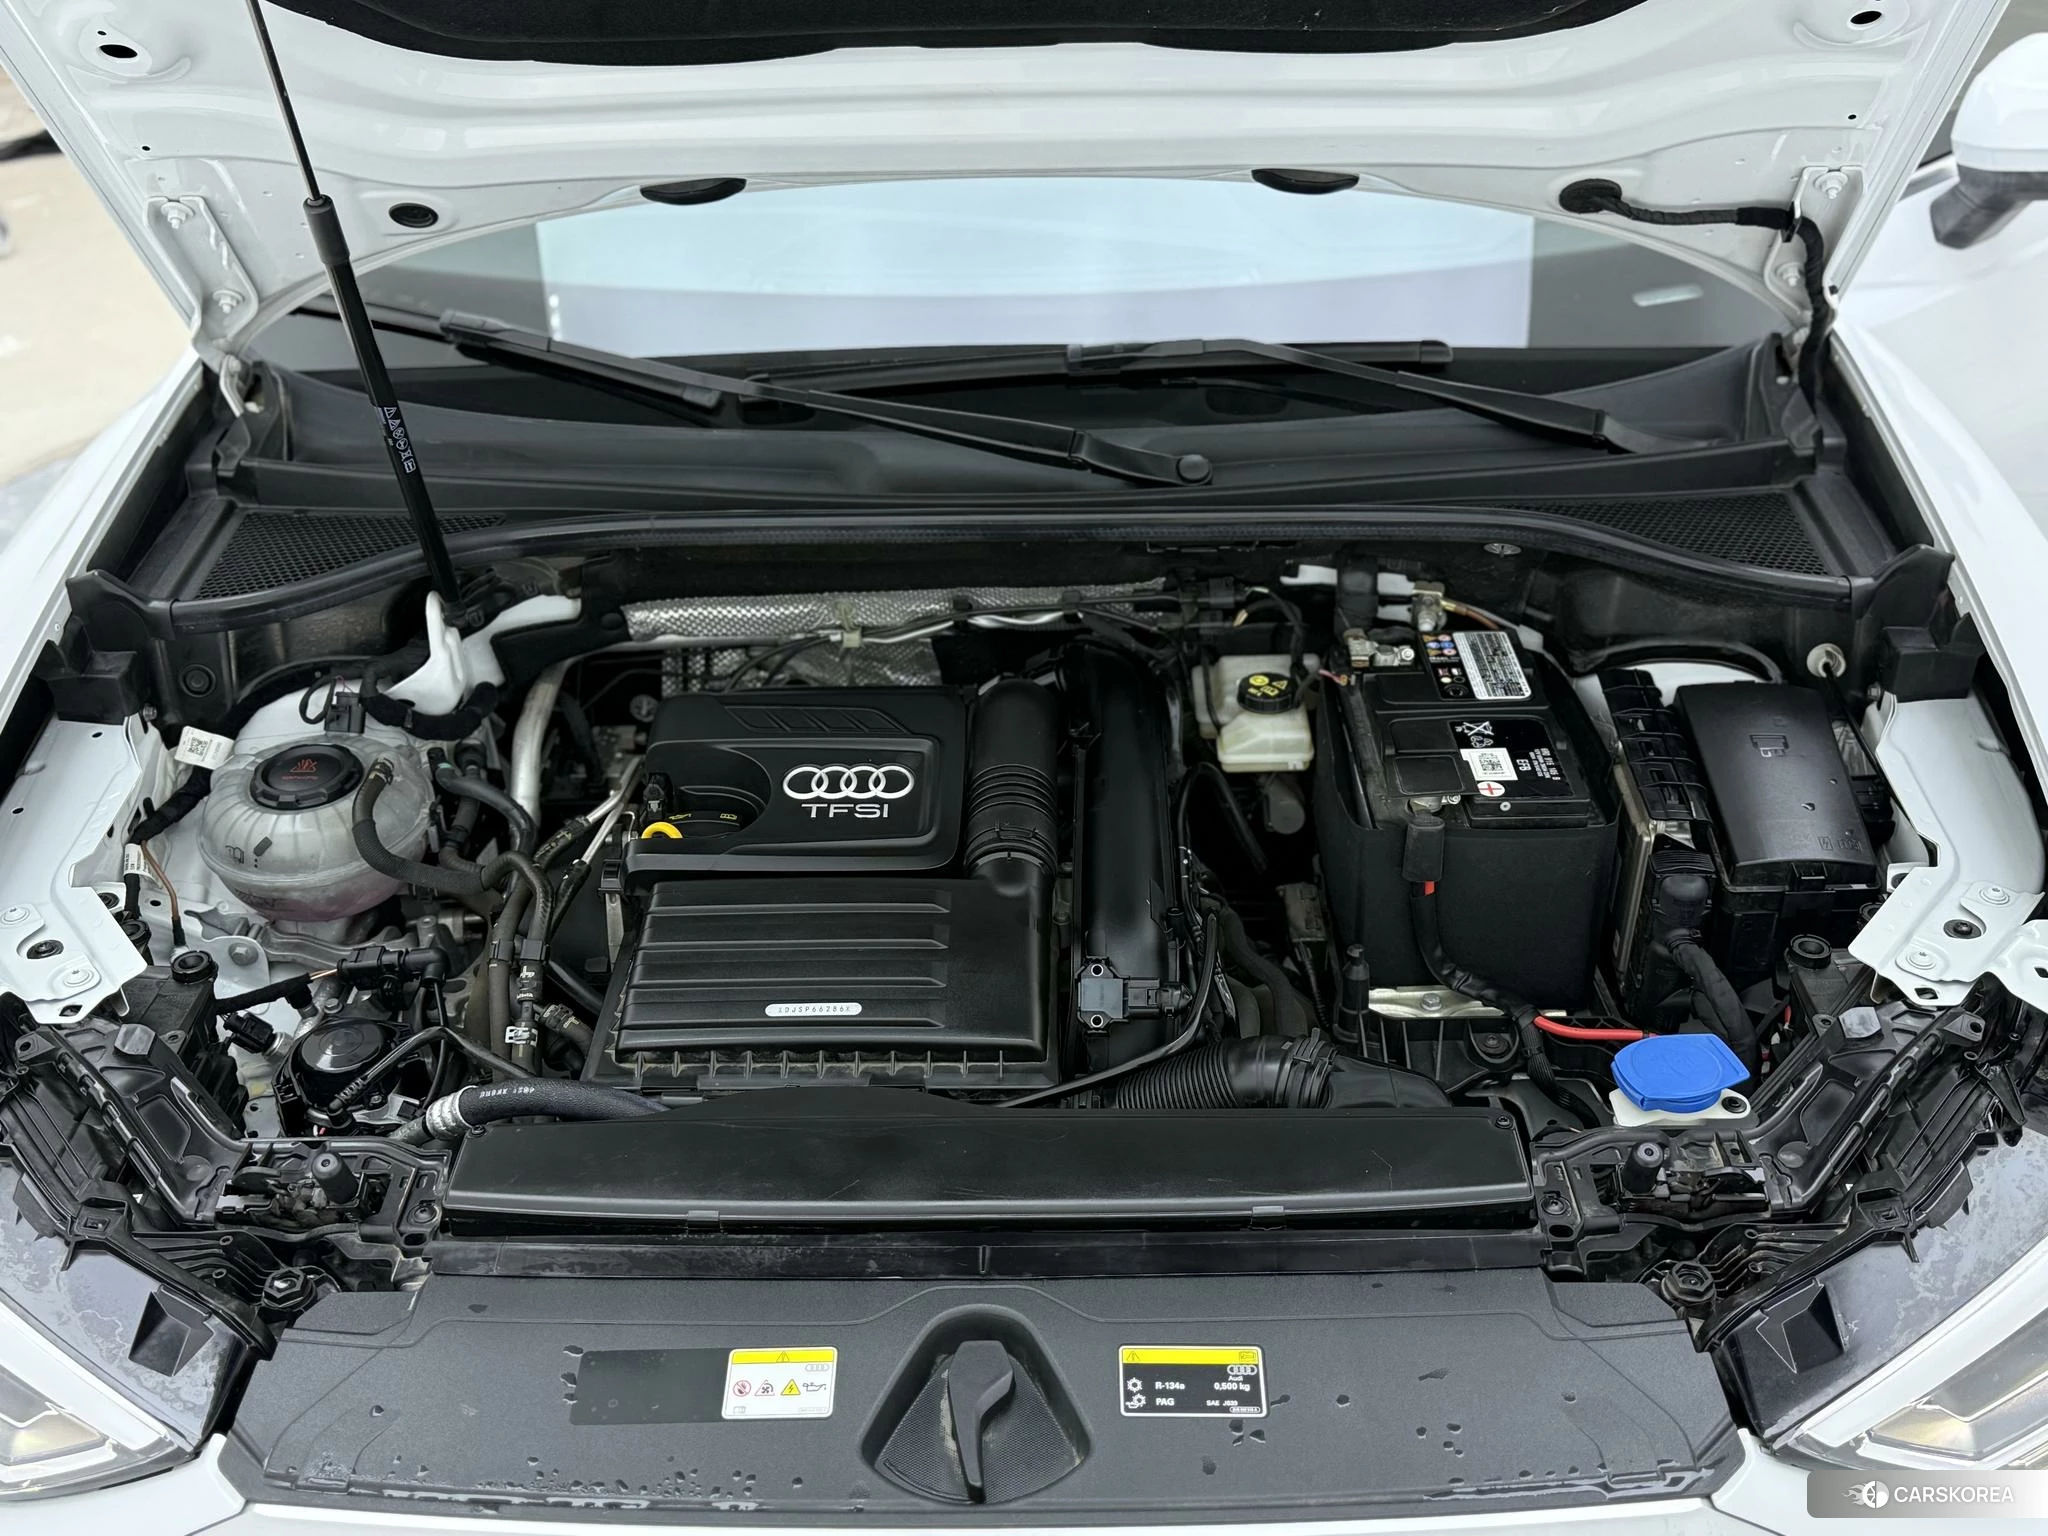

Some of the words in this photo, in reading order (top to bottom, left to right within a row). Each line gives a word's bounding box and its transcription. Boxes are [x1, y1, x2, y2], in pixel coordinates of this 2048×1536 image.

[1516, 759, 1532, 771] EFB
[801, 803, 889, 818] TFSI
[1155, 1381, 1186, 1390] R-134a
[1213, 1382, 1238, 1391] 0,500
[1239, 1382, 1251, 1392] kg
[1155, 1397, 1175, 1406] PAG
